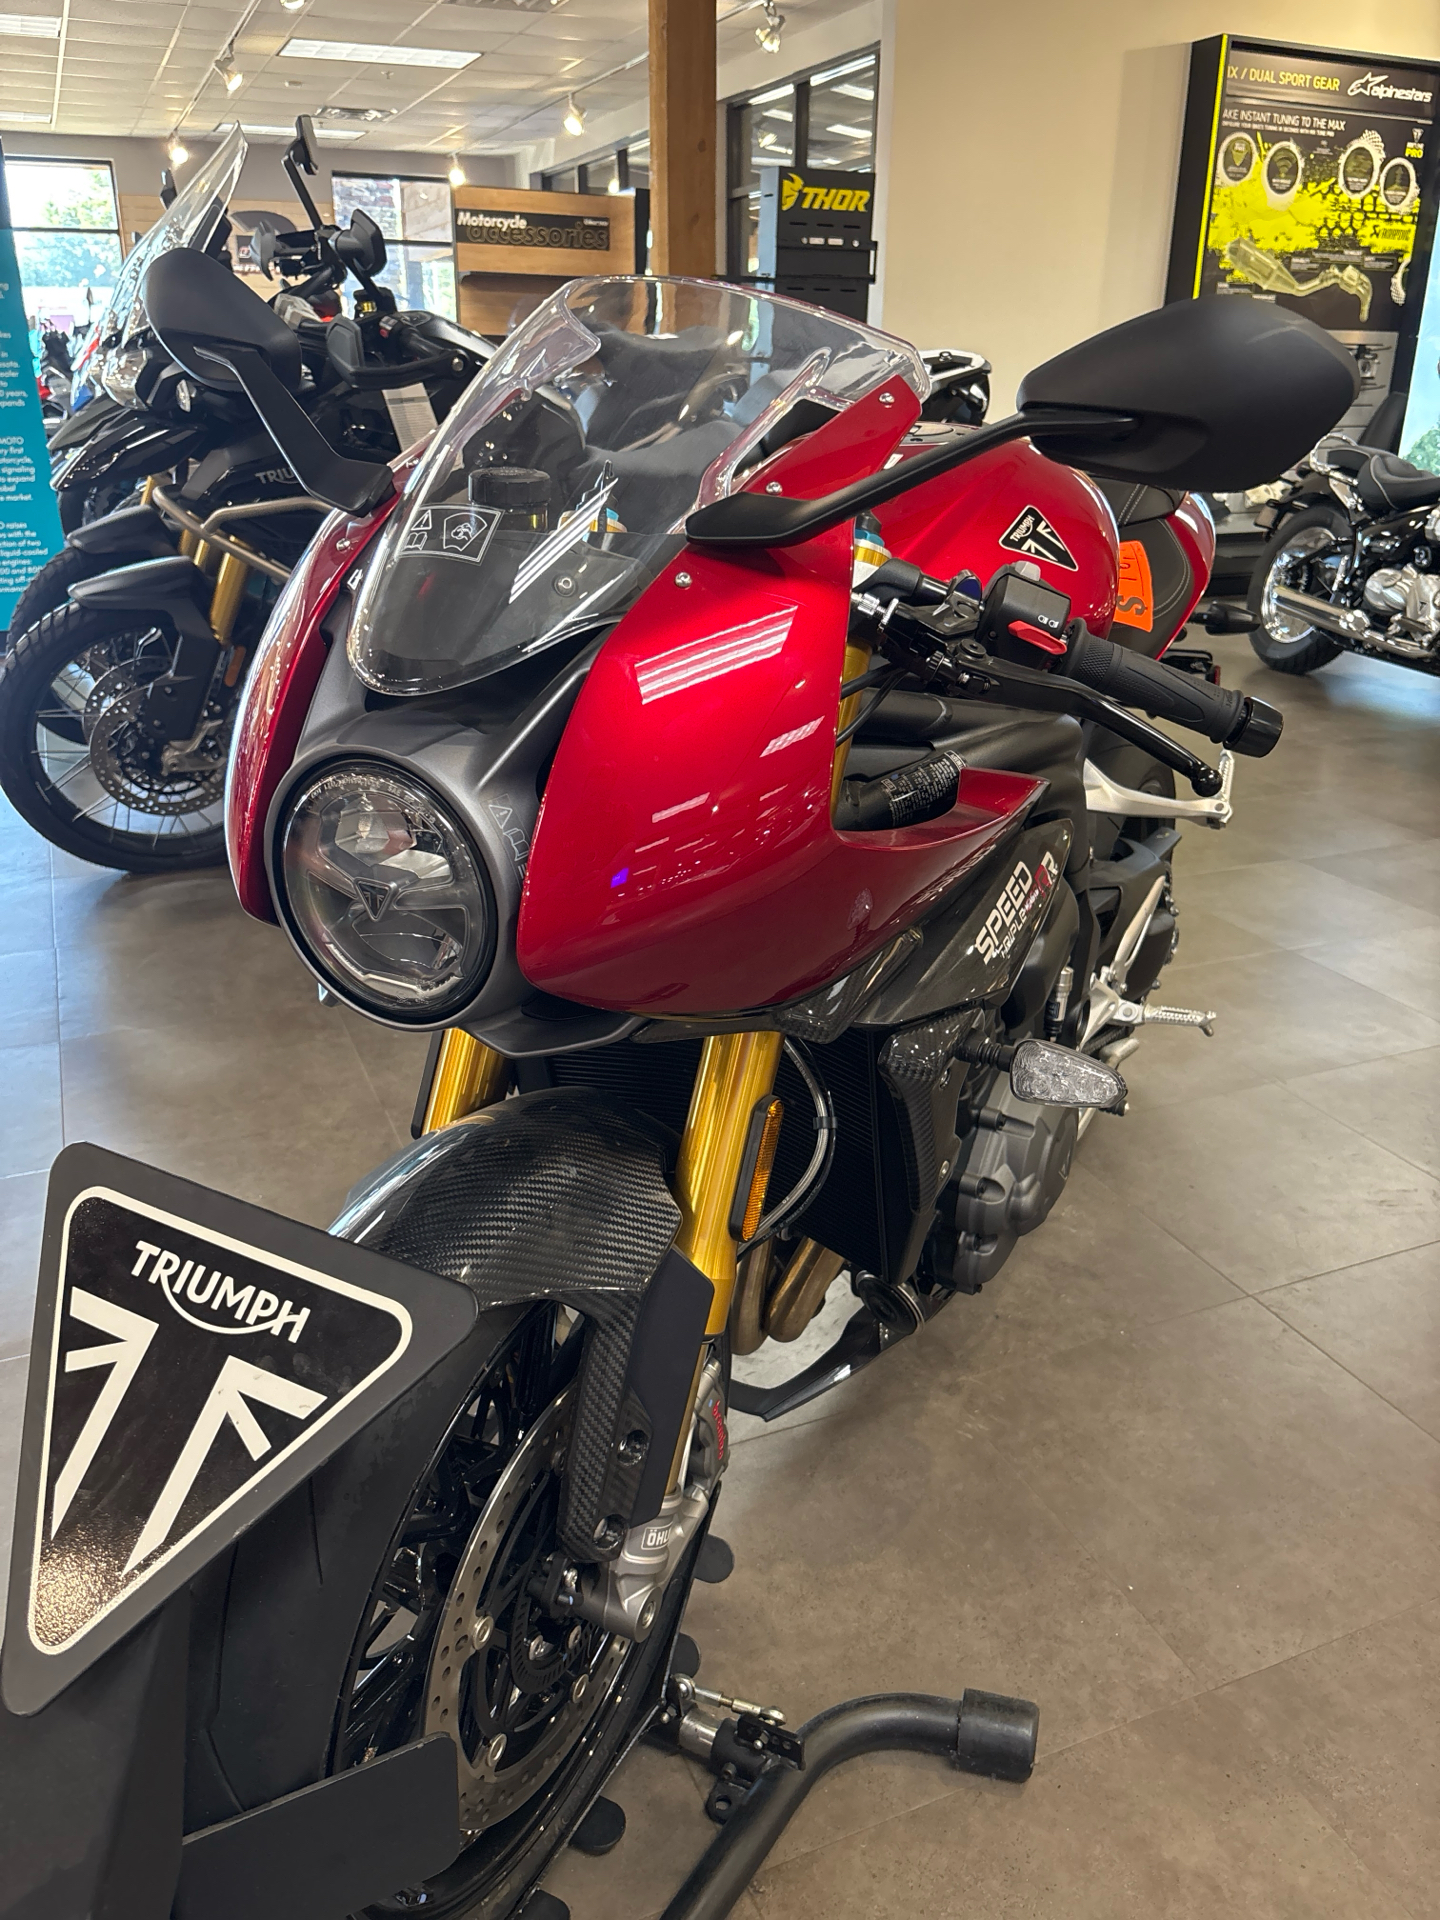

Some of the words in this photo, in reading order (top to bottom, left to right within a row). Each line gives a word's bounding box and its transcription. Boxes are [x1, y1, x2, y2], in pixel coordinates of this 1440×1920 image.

[1249, 68, 1276, 84] DUAL
[1279, 71, 1312, 88] SPORT
[1313, 76, 1340, 92] GEAR
[1370, 83, 1433, 103] alpinestars
[1222, 108, 1239, 120] AKE
[1240, 110, 1271, 124] INSTANT
[1273, 113, 1300, 127] TUNING
[1301, 116, 1311, 128] TO
[1312, 117, 1328, 130] THE
[1328, 119, 1346, 132] MAX
[1406, 148, 1424, 158] PRO
[801, 187, 870, 212] THOR
[457, 212, 527, 231] Motorcycle
[467, 222, 609, 249] accessories
[254, 466, 298, 485] TRIU
[1010, 514, 1035, 542] TRIUMPH
[975, 861, 1033, 965] SPEED
[996, 908, 1027, 959] TRIPLE
[131, 1240, 311, 1344] TRIUMPH
[647, 1529, 670, 1546] ÖHL
